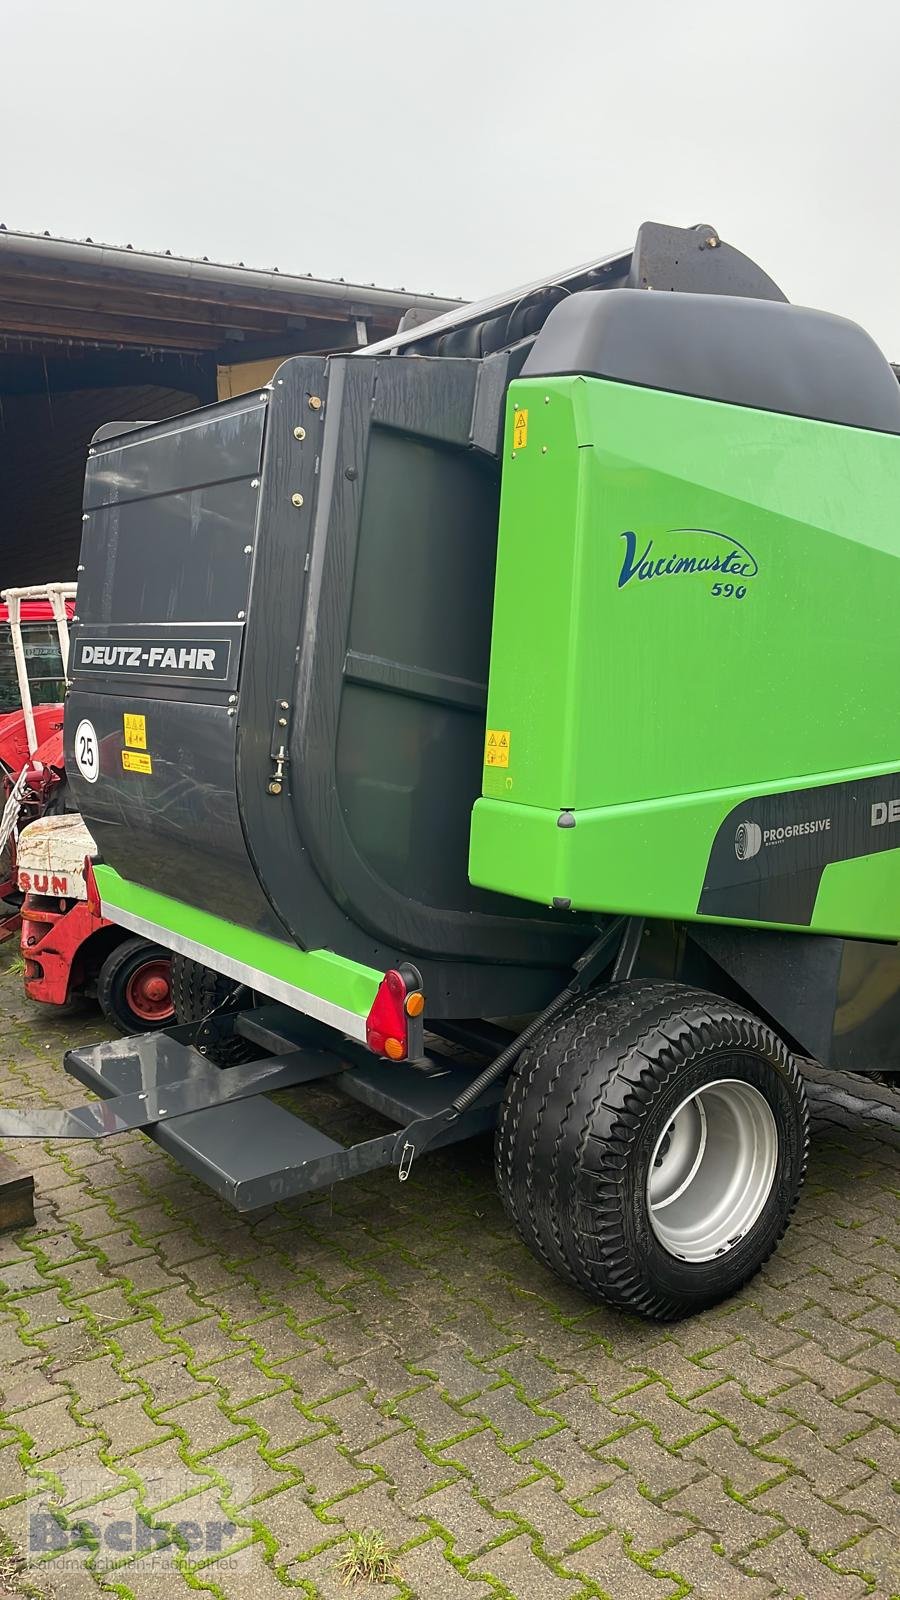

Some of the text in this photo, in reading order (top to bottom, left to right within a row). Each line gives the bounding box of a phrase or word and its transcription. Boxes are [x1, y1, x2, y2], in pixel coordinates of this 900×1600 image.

[710, 582, 747, 600] 590
[81, 646, 216, 670] DEUTZ-FAHR
[79, 737, 95, 767] 25
[763, 819, 831, 842] PROGRESSIVE
[19, 873, 68, 894] SUN
